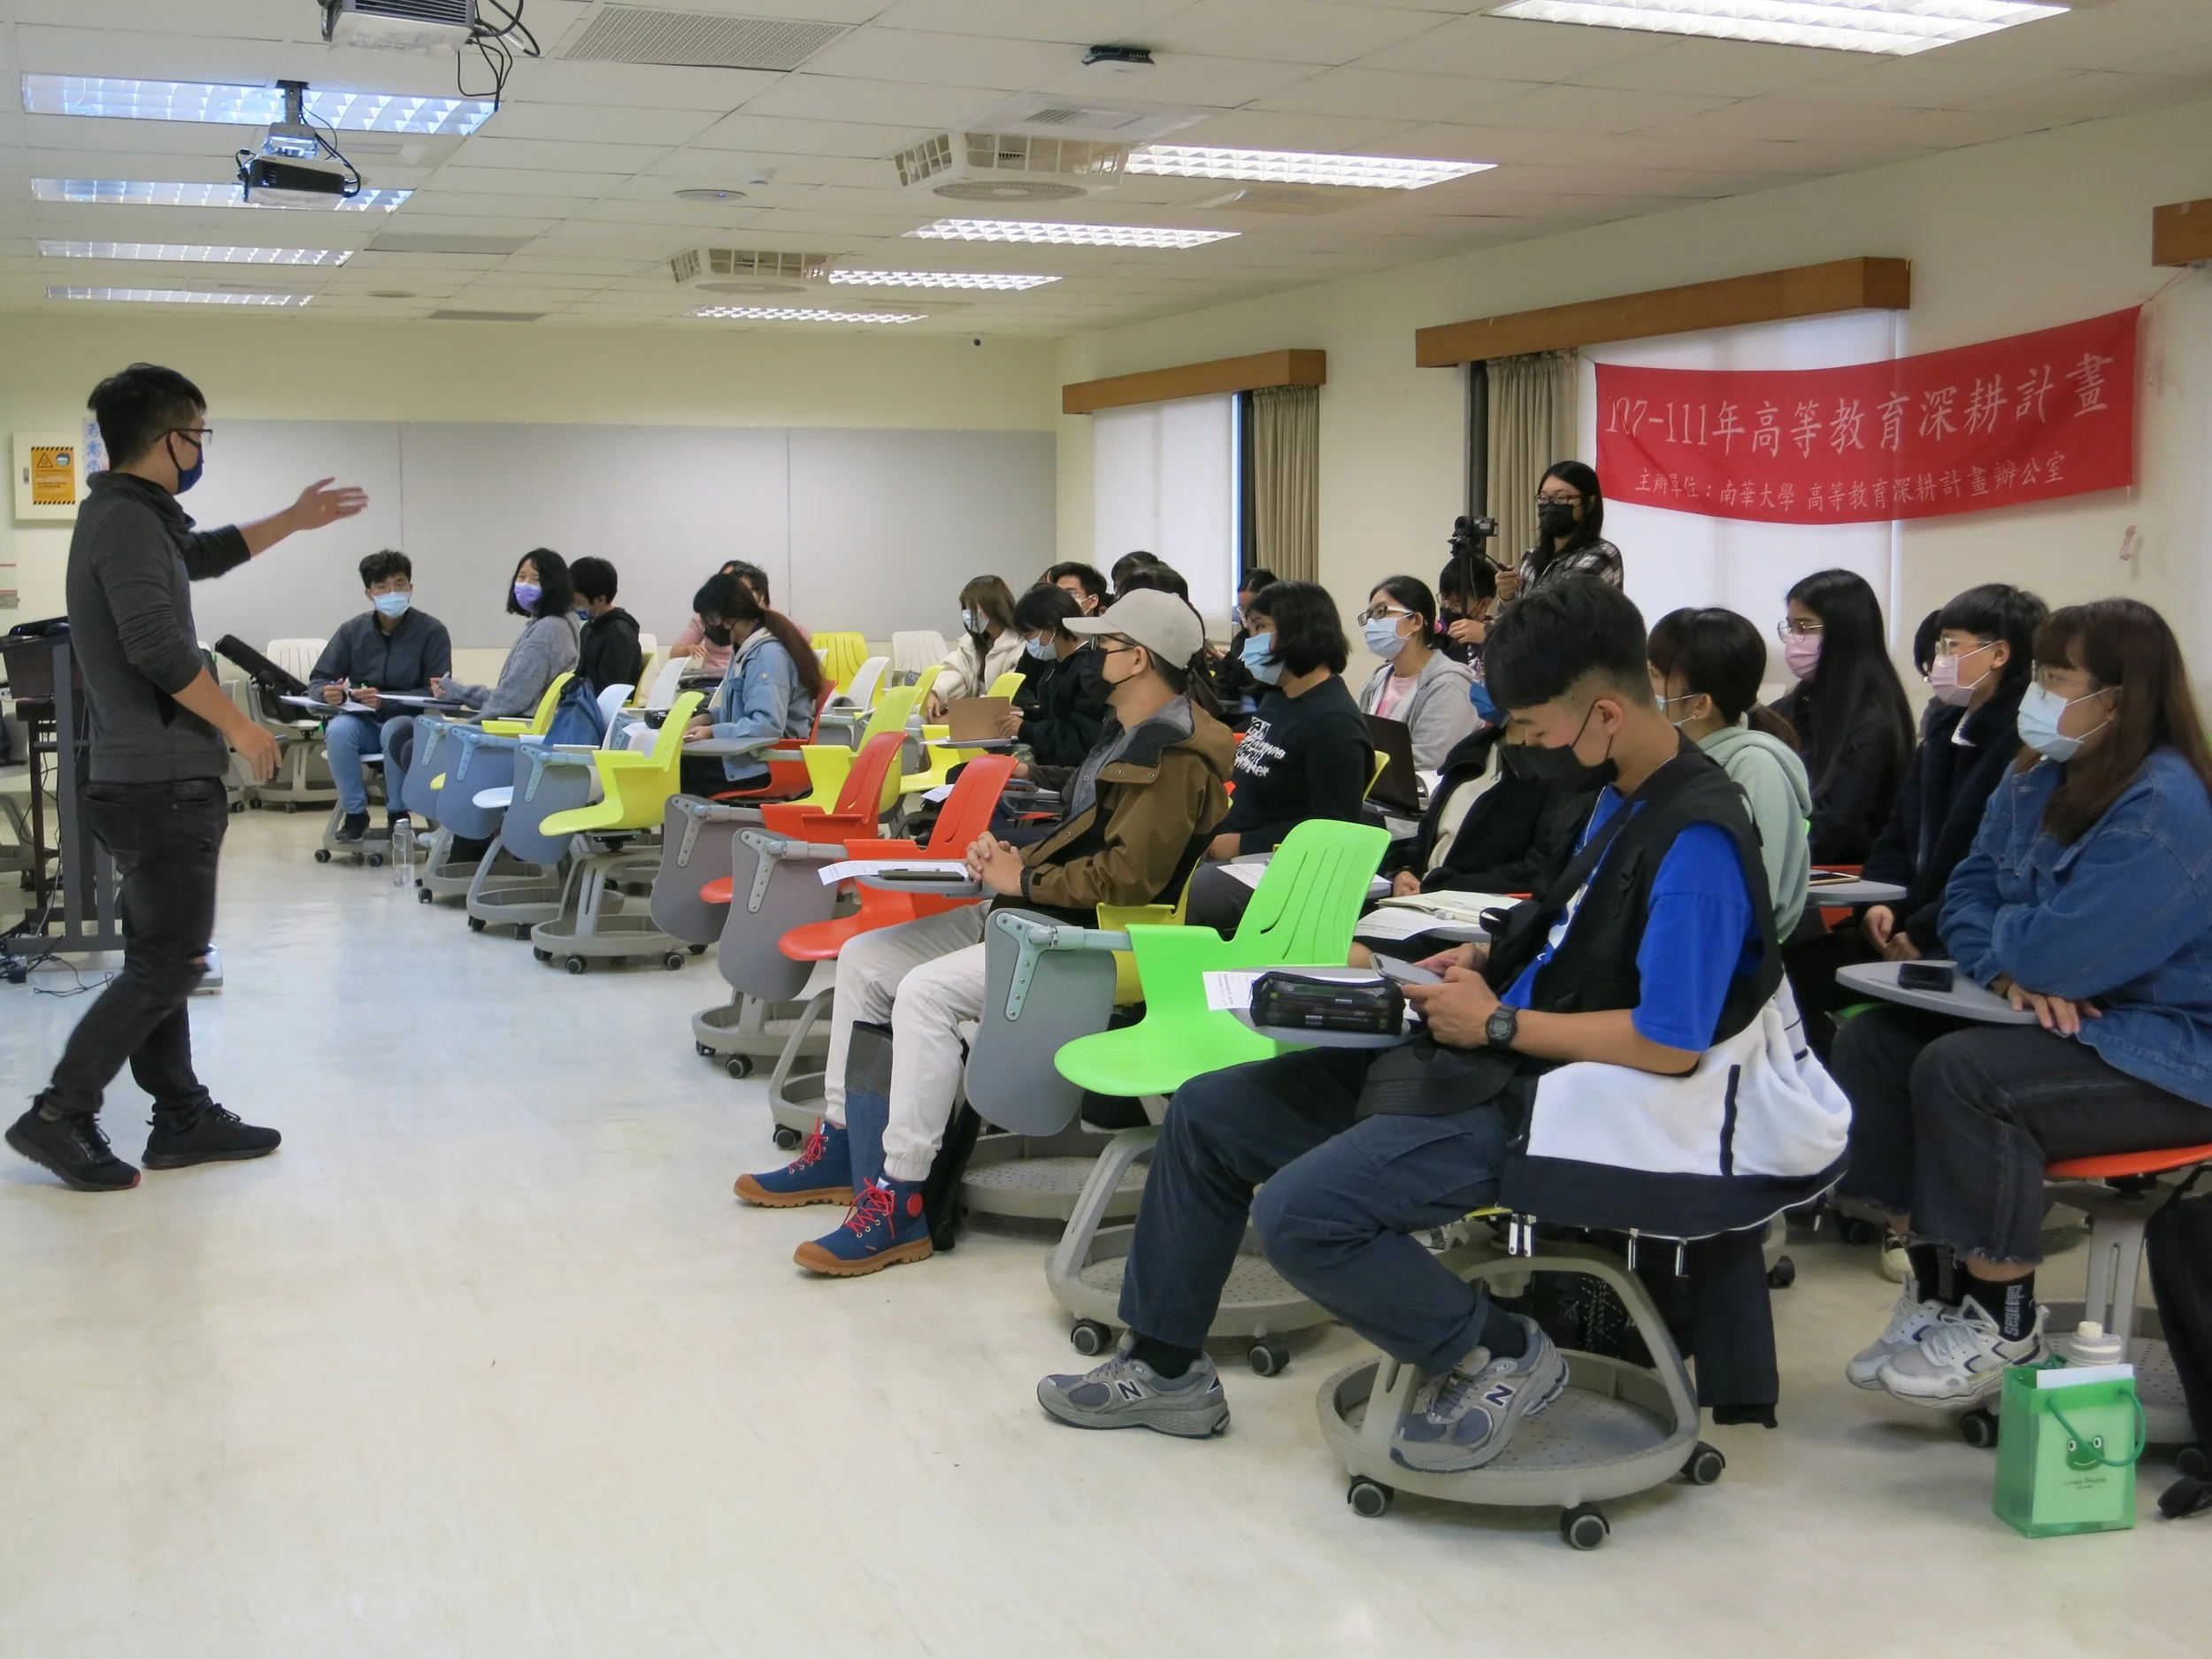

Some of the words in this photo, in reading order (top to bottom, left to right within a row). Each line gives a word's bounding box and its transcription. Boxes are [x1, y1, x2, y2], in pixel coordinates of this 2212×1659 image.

[1605, 352, 2114, 459] 107-111年高等教育深耕計畫
[1117, 1380, 1143, 1400] N
[1485, 1384, 1513, 1407] N
